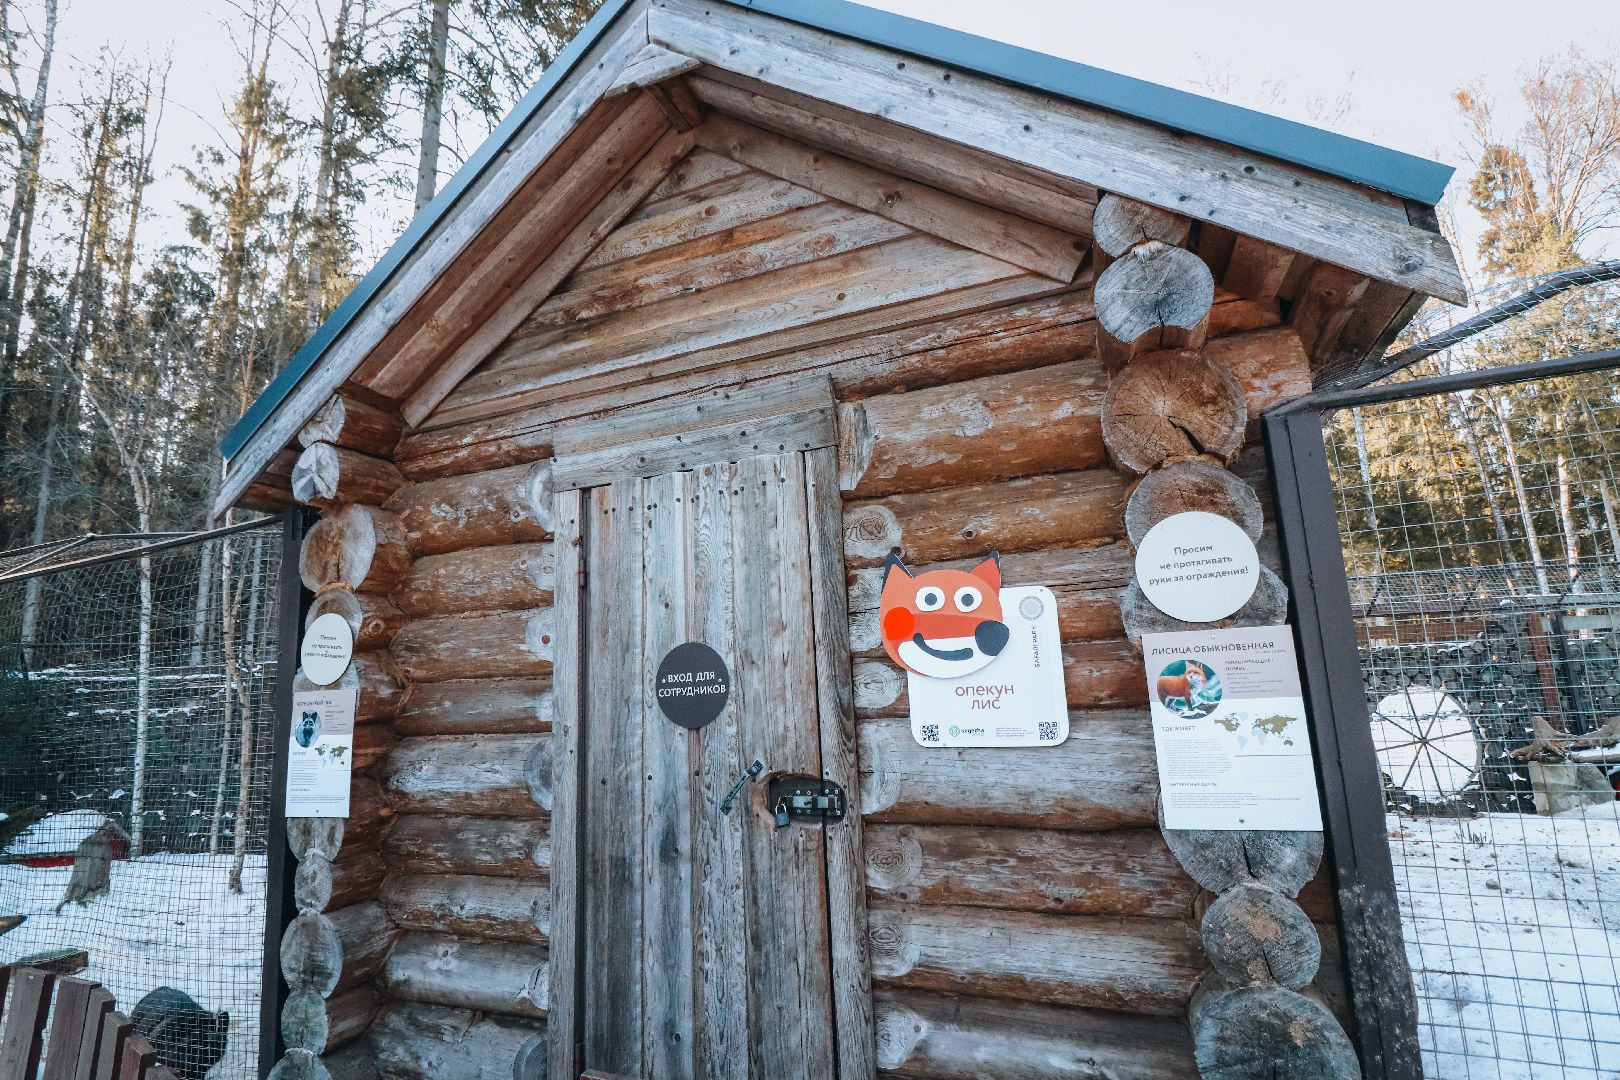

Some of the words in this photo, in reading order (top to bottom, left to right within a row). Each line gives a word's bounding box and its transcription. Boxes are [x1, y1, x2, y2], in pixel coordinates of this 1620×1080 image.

[1174, 545, 1213, 558] Просим
[1174, 556, 1233, 570] протягивать
[1149, 577, 1172, 586] руки
[1186, 566, 1249, 582] ограждения!
[1151, 646, 1192, 656] ЛИСИЦА
[1193, 641, 1275, 654] ОБЫКНОВЕННАЯ
[668, 673, 693, 683] ВХОД
[696, 671, 715, 683] ДЛЯ
[658, 684, 726, 698] СОТРУДНИКОВ
[955, 684, 1014, 698] опекун
[971, 698, 1001, 710] лис
